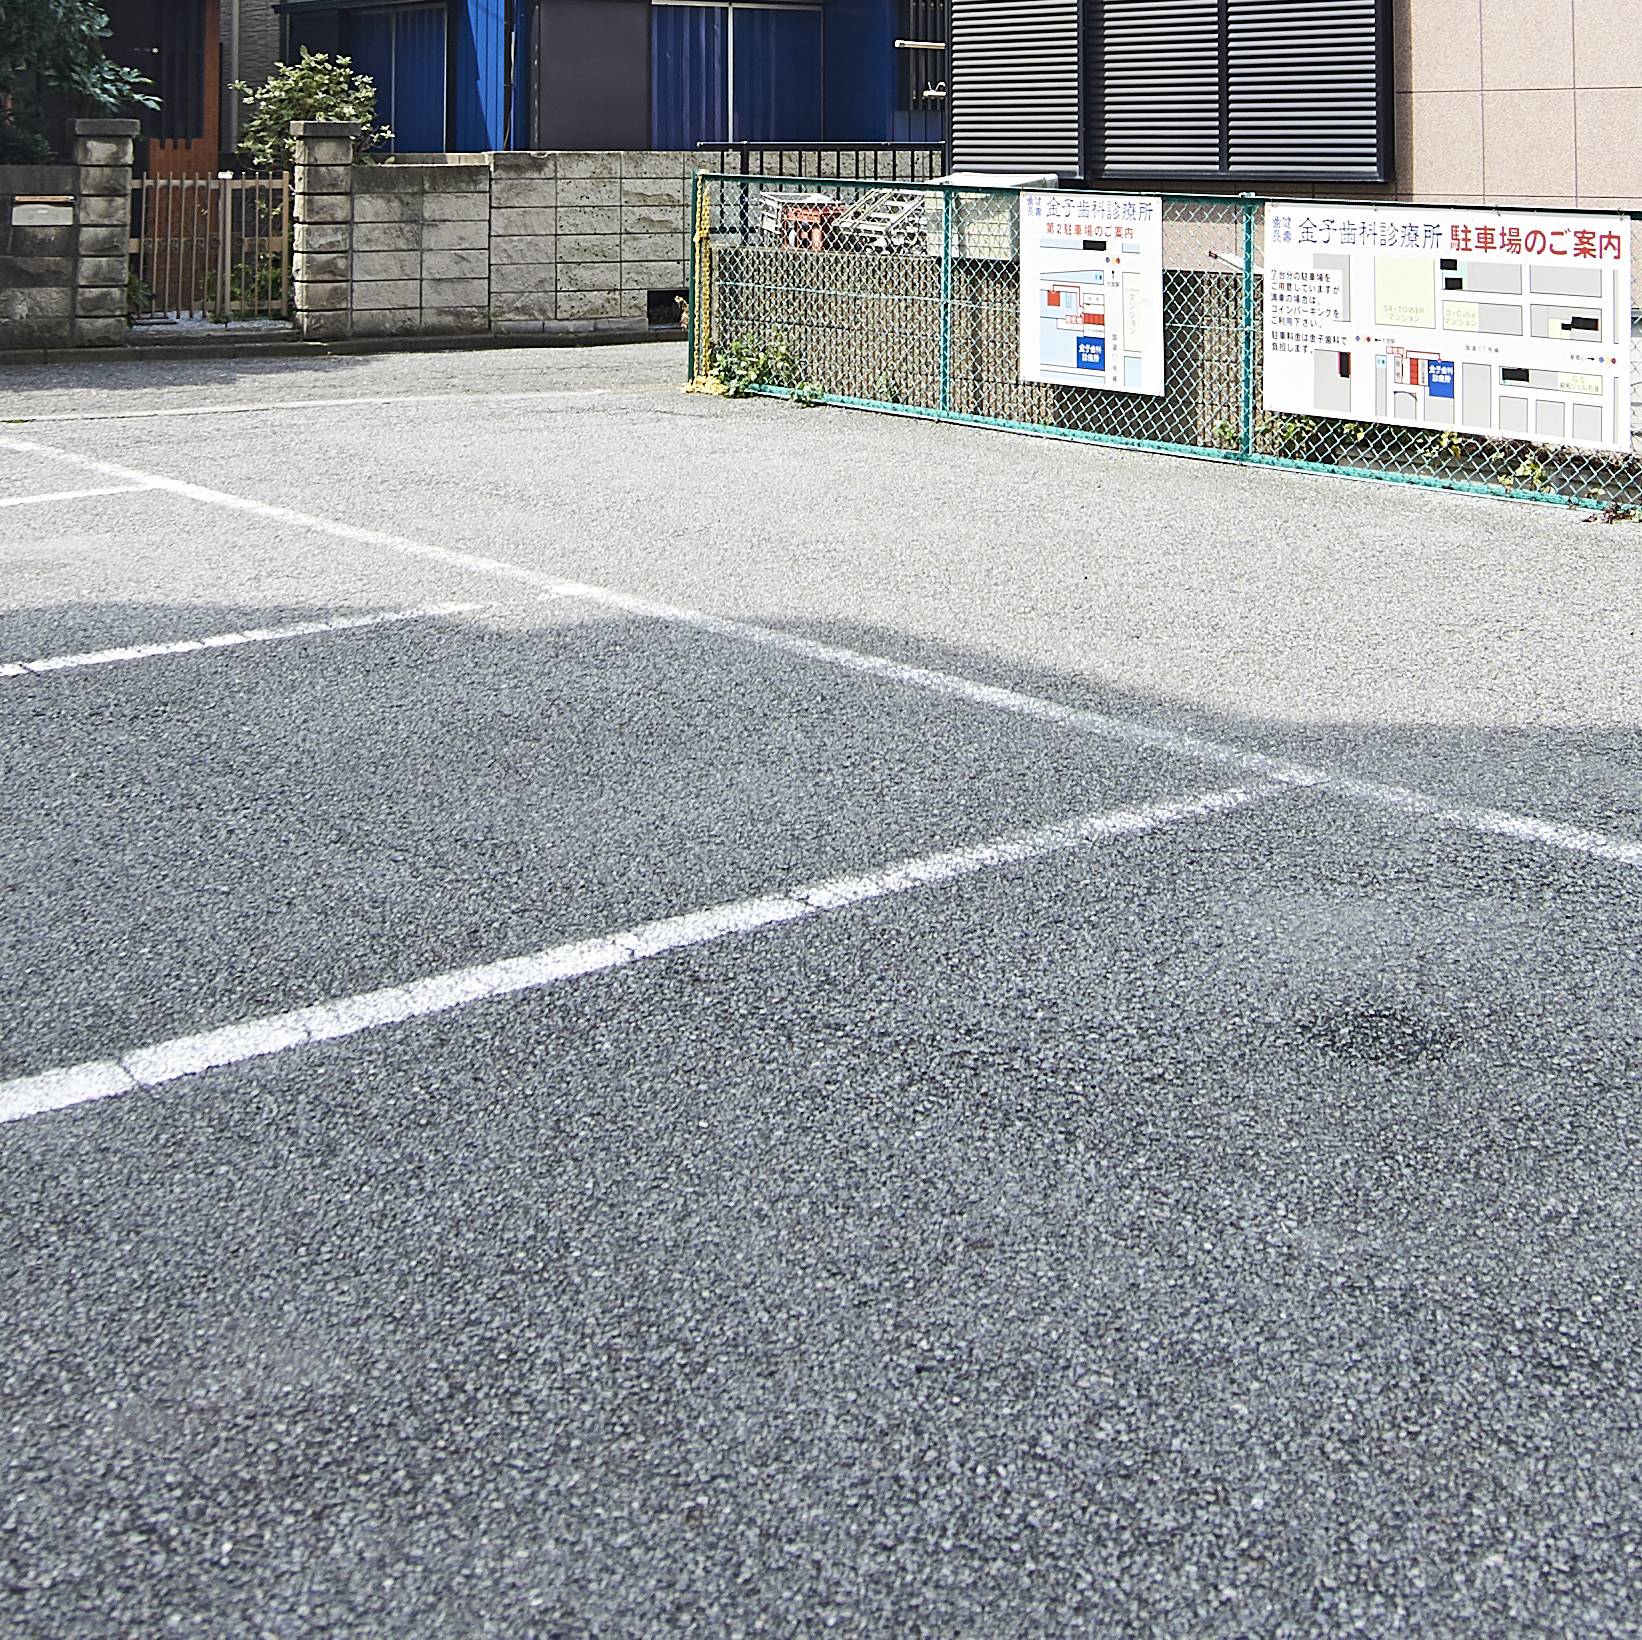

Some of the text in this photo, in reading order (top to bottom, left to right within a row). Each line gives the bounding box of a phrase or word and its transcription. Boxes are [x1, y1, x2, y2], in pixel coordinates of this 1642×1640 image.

[1046, 196, 1153, 221] 金子歯科診療所
[1297, 217, 1621, 260] 金子歯科診療所 駐車場のご案内
